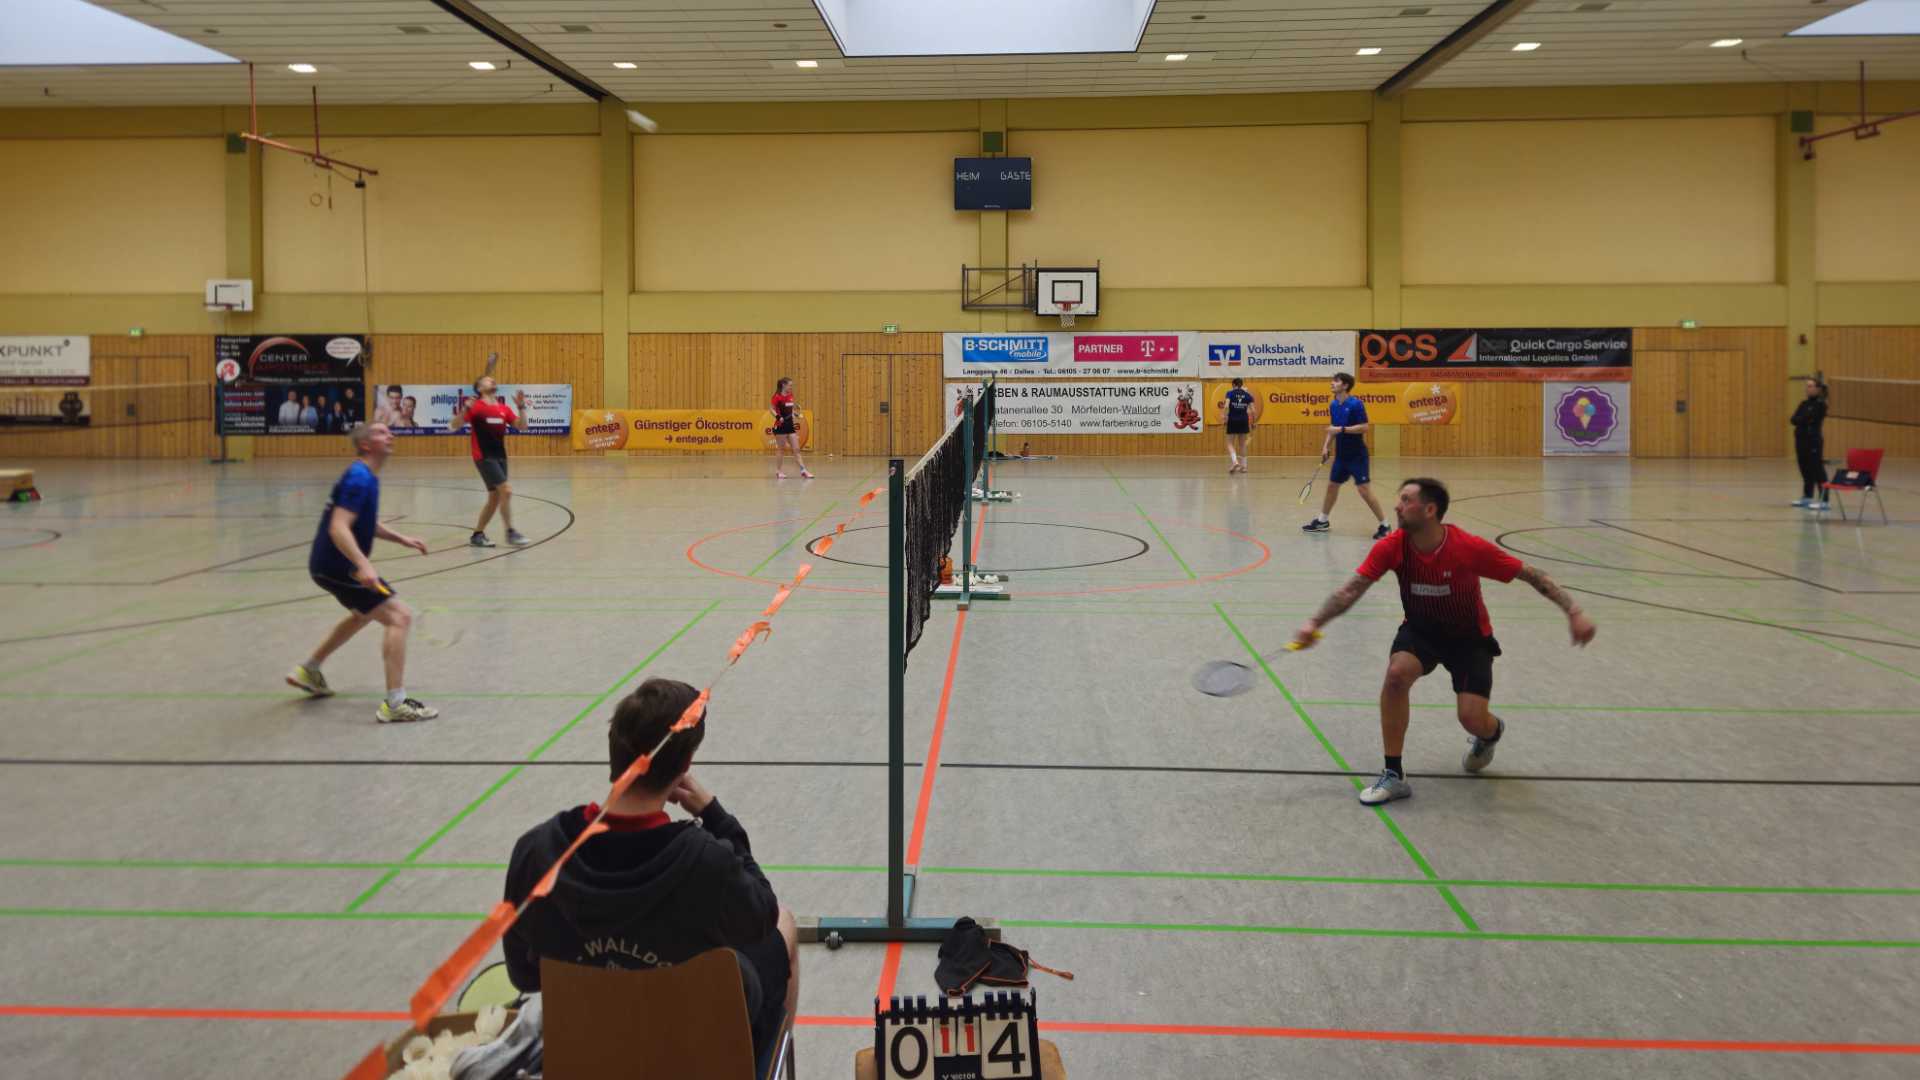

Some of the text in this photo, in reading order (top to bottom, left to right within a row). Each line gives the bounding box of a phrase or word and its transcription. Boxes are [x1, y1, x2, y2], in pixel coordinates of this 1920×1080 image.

[957, 172, 980, 181] HEIM
[1078, 344, 1123, 353] PARTNER
[1248, 344, 1304, 354] Volksbank
[1361, 333, 1438, 368] QCS
[1511, 339, 1545, 352] Quick
[1546, 339, 1583, 352] Cargo
[1584, 338, 1628, 350] Service
[259, 353, 308, 363] CENTER
[1014, 350, 1042, 358] mobile
[1479, 354, 1531, 362] International
[1532, 354, 1570, 363] Logistics
[1248, 355, 1345, 366] Darmstadt Mainz
[1021, 387, 1028, 397] &
[1031, 386, 1136, 397] RAUMAUSSTATTUNG
[1139, 386, 1169, 396] KRUG
[1269, 392, 1330, 405] Günstiger
[1409, 395, 1447, 409] entega
[1051, 405, 1063, 414] 30
[1071, 404, 1161, 415] Mörfelden-Walldorf
[585, 422, 620, 435] entega
[634, 419, 692, 431] Günstiger
[695, 417, 753, 430] Ökostrom
[1021, 418, 1072, 428] 06105-5140
[1080, 418, 1161, 430] www.farbenkrug.de
[675, 435, 724, 444] entega.de
[988, 1022, 1026, 1074] 4
